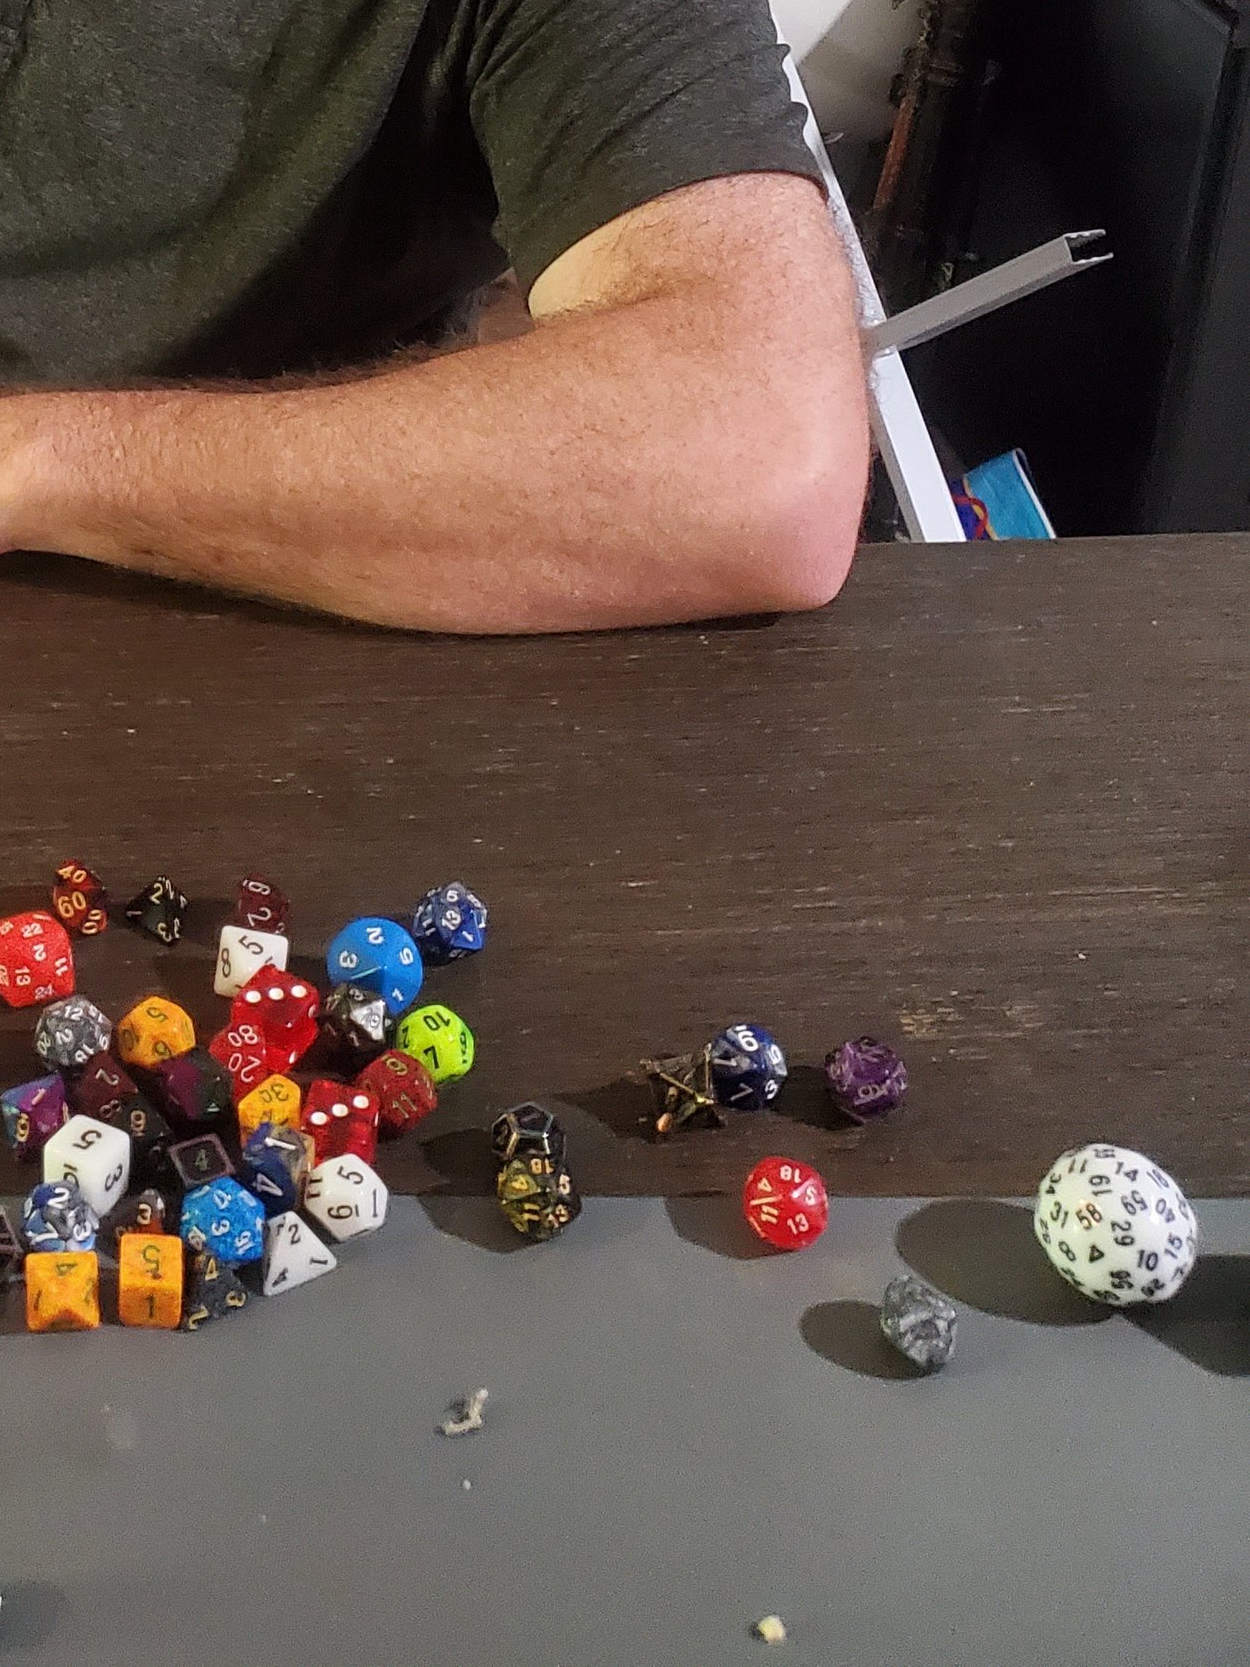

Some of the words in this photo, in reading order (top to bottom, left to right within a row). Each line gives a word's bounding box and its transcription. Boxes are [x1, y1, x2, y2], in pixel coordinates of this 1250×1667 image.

[58, 865, 87, 883] 40
[150, 883, 163, 904] 2
[58, 891, 86, 918] 60
[238, 935, 264, 955] 5
[366, 927, 384, 944] 2
[221, 947, 231, 978] 8
[339, 950, 358, 968] 3
[64, 1005, 83, 1021] 12
[423, 1011, 451, 1031] 10
[228, 1025, 258, 1047] 80
[229, 1053, 261, 1082] 20
[423, 1045, 439, 1069] 7
[73, 1130, 102, 1150] 5
[265, 1137, 296, 1150] 1
[105, 1163, 123, 1191] 3
[253, 1173, 283, 1196] 4
[337, 1166, 364, 1185] 5
[779, 1165, 802, 1183] 18
[48, 1187, 70, 1209] 2
[1121, 1190, 1148, 1216] 59
[786, 1213, 810, 1234] 13
[1076, 1203, 1102, 1230] 58
[288, 1223, 301, 1245] 2
[1111, 1221, 1135, 1246] 29
[1058, 1241, 1076, 1262] 8
[1089, 1244, 1105, 1263] 4
[1137, 1250, 1158, 1271] 10
